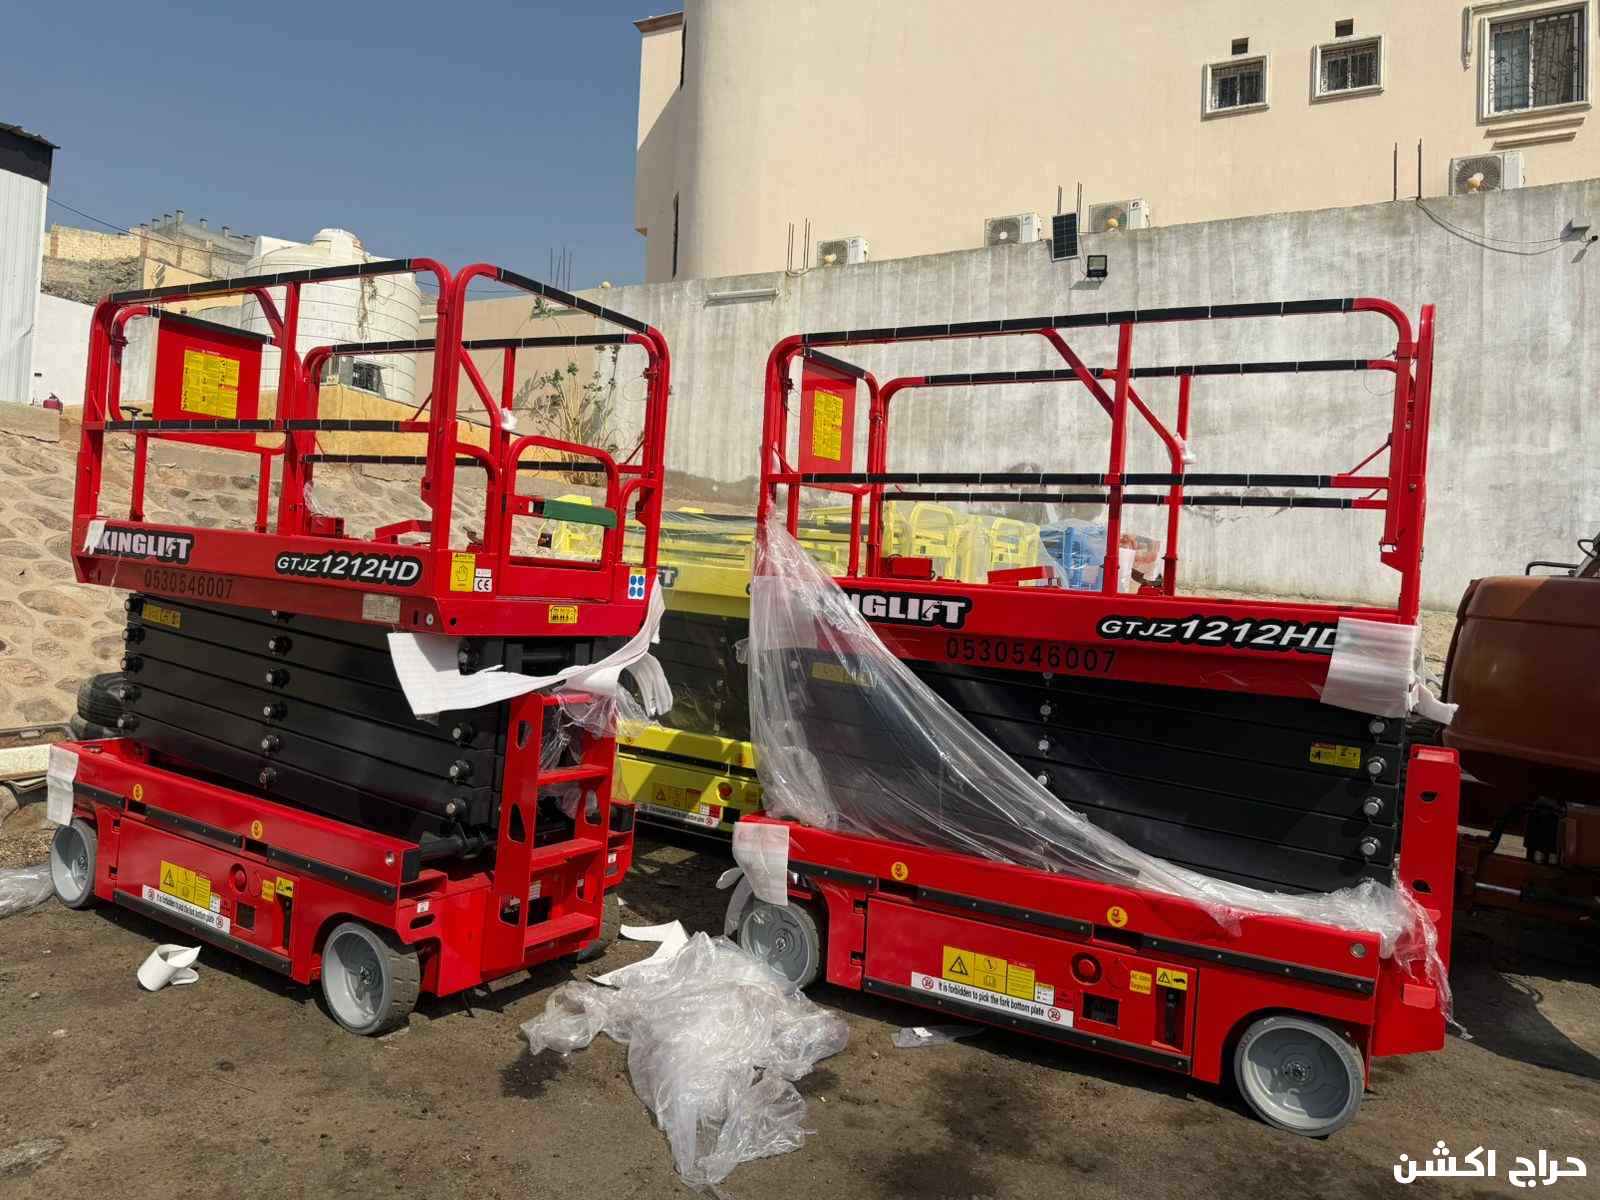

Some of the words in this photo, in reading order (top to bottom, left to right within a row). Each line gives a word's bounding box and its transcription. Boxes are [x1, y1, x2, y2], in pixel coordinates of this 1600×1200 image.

[97, 530, 192, 560] KINGLIFT
[144, 567, 233, 599] 0530546007
[277, 554, 420, 582] GTJZ1212HD
[477, 579, 490, 591] CE
[851, 593, 966, 624] GLIFT
[945, 637, 1118, 674] 0530546007
[948, 983, 972, 999] forbidden
[978, 991, 989, 1003] pick
[990, 993, 999, 1005] the
[1010, 999, 1030, 1013] bottom
[1031, 1004, 1044, 1017] plate
